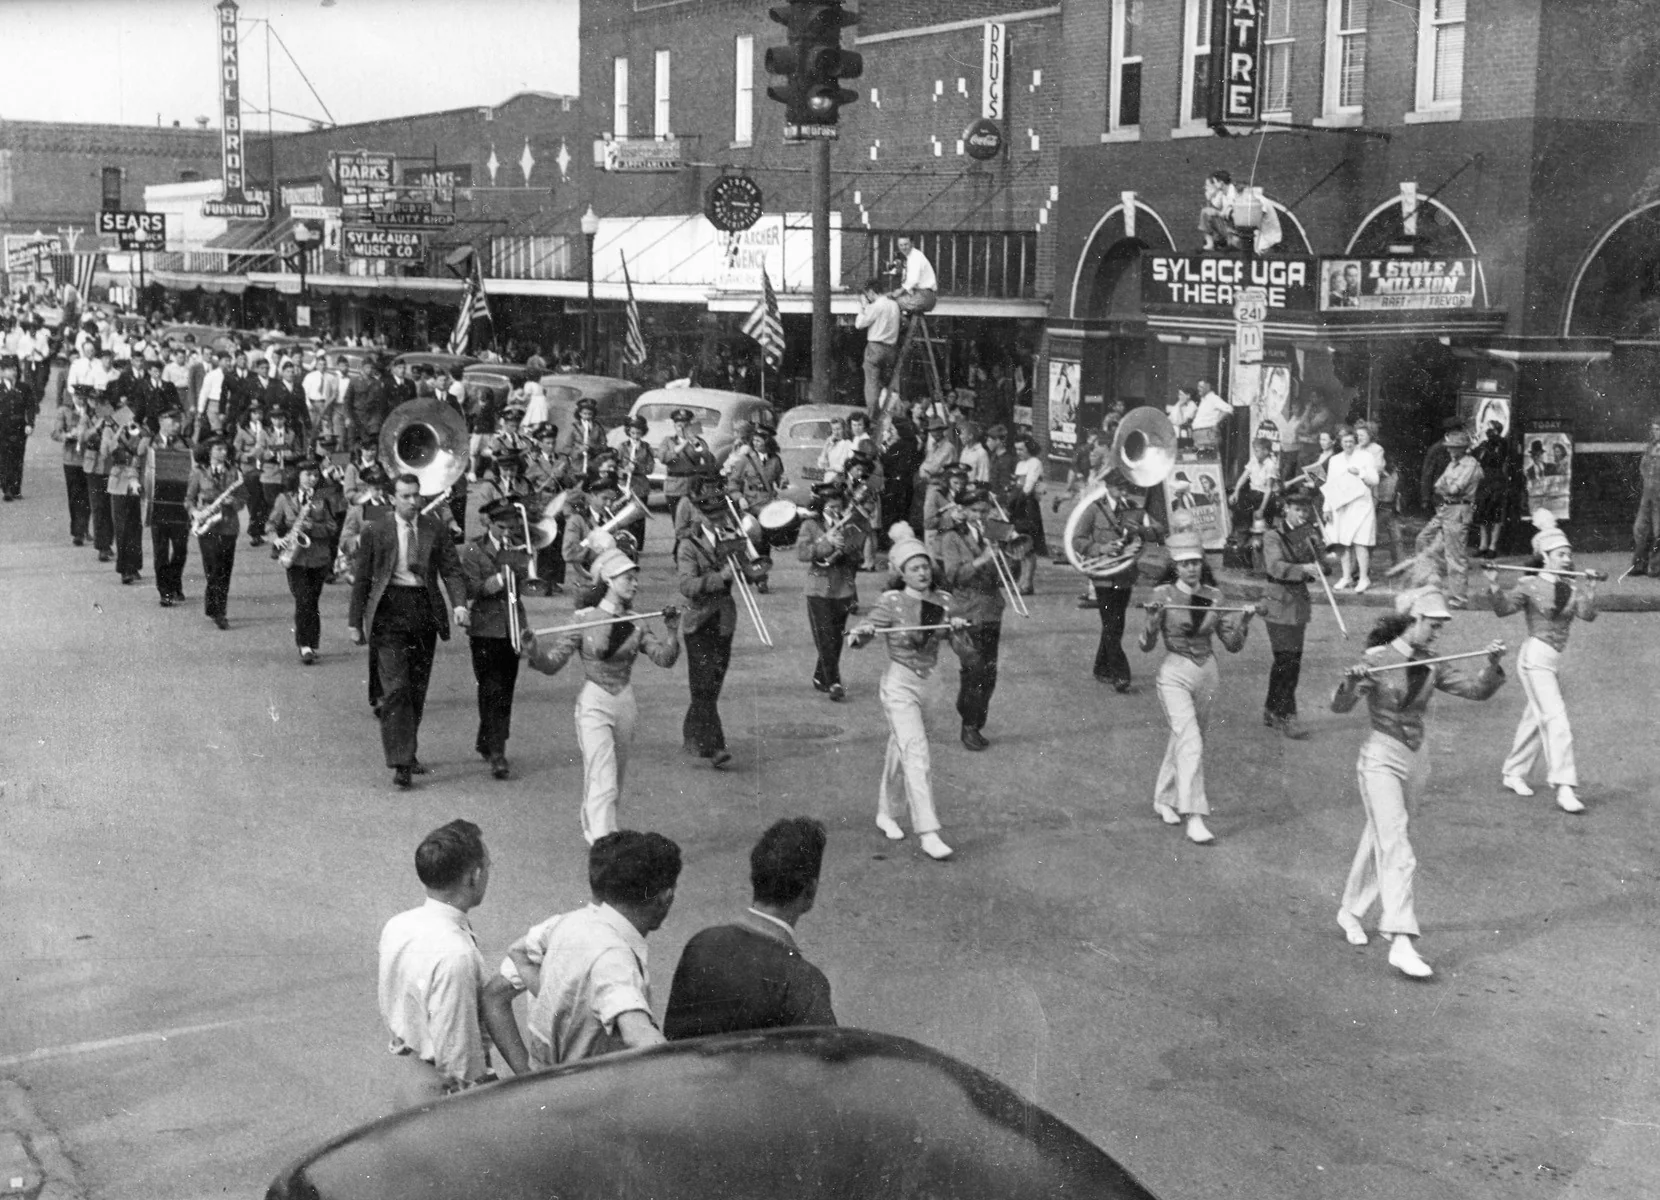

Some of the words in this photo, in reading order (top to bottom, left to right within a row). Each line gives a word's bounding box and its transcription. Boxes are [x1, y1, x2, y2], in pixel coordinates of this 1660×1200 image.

[221, 7, 237, 101] SOKOL
[988, 24, 1000, 119] DRUGS
[225, 115, 241, 188] BROS
[204, 202, 265, 217] FURNITURE
[102, 214, 163, 231] SEARS
[422, 214, 454, 224] SHOP
[121, 233, 164, 243] ROUCK
[346, 231, 419, 245] SYLACAUGA
[353, 244, 392, 257] MUSIC
[396, 245, 414, 258] CO
[1368, 260, 1382, 278] I
[1386, 260, 1447, 277] STOLE
[1449, 260, 1466, 277] A
[1373, 276, 1459, 295] MILLION
[1428, 294, 1467, 308] TREVOR
[1239, 307, 1262, 321] 241
[1244, 333, 1256, 346] 11
[1532, 420, 1562, 429] TODAY
